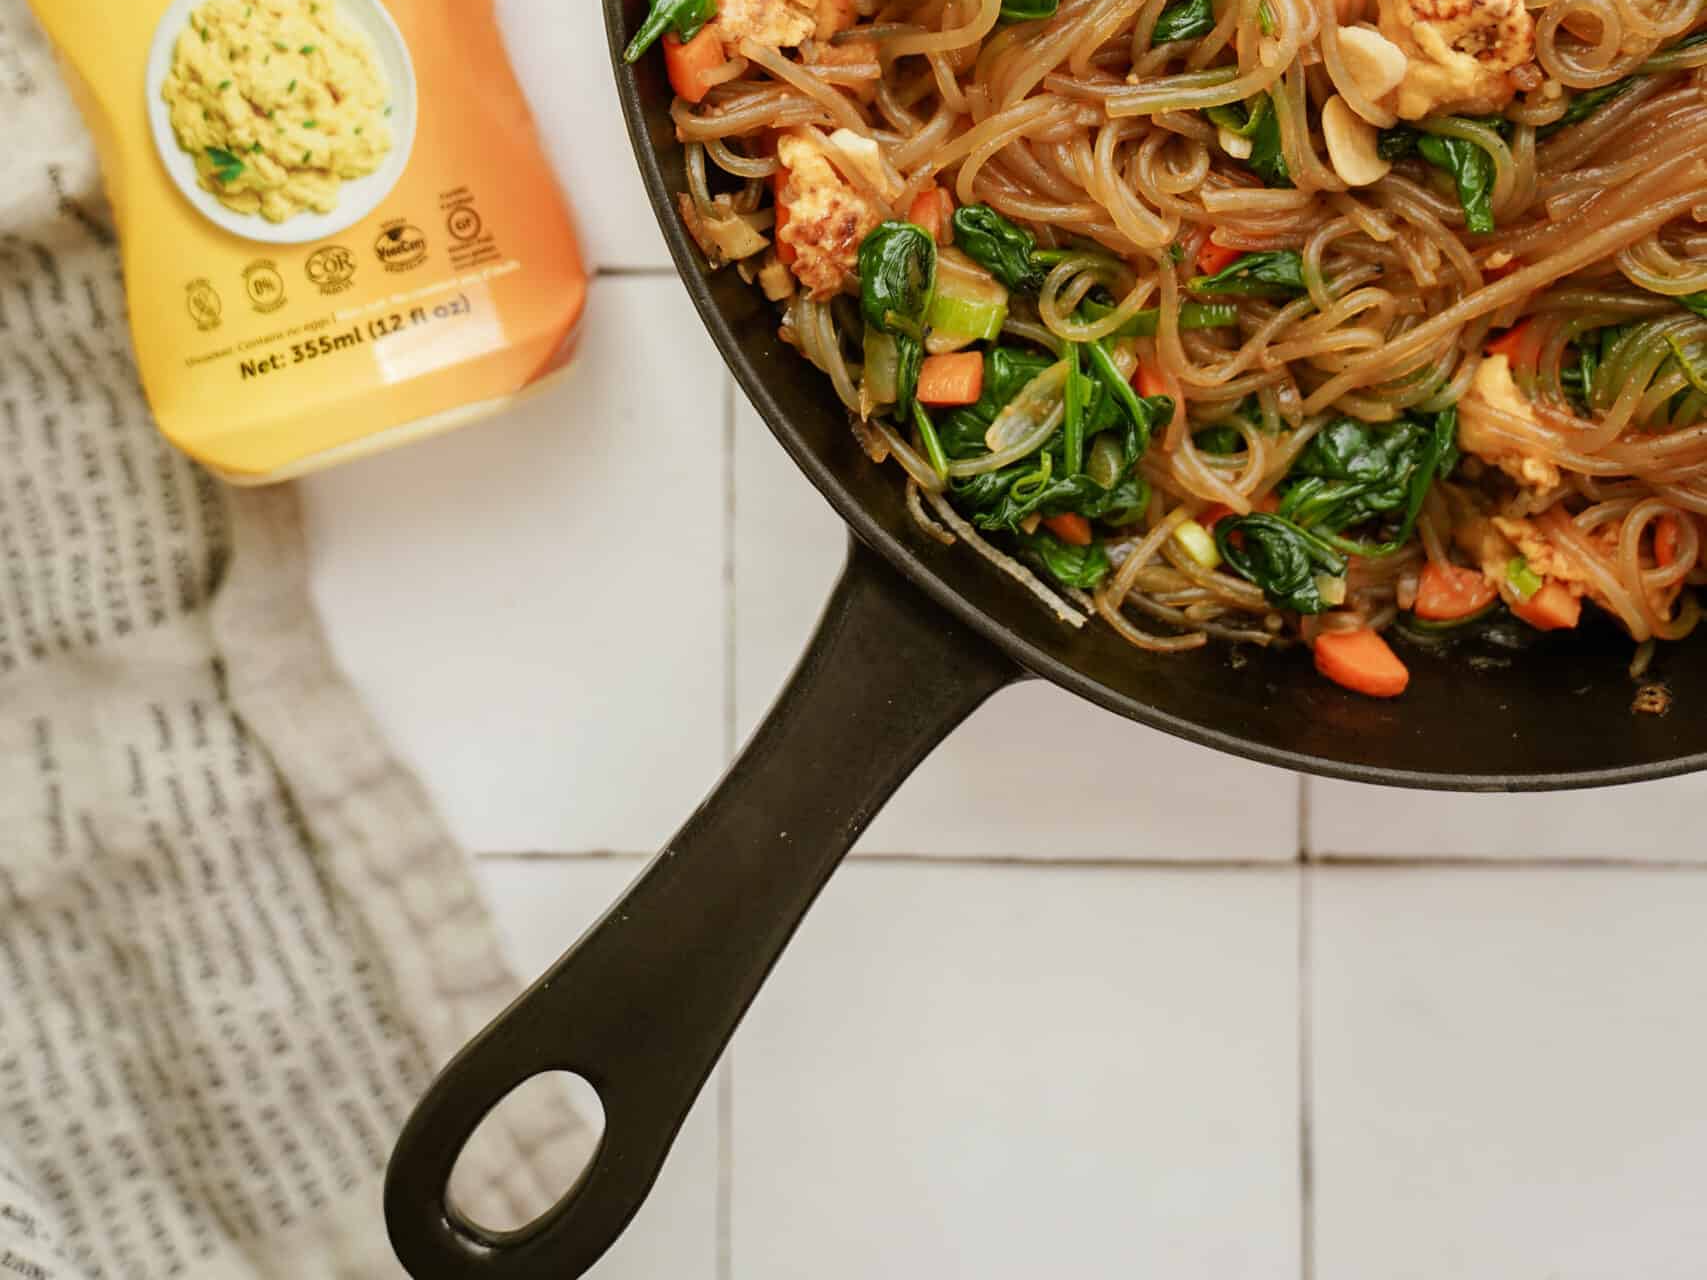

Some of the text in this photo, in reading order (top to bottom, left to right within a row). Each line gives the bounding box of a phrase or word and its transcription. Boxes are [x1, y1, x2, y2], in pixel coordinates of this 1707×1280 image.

[240, 353, 287, 380] Net:
[290, 326, 364, 364] 355ml
[368, 313, 405, 342] (12
[409, 303, 428, 326] fl
[433, 295, 471, 320] oz)
